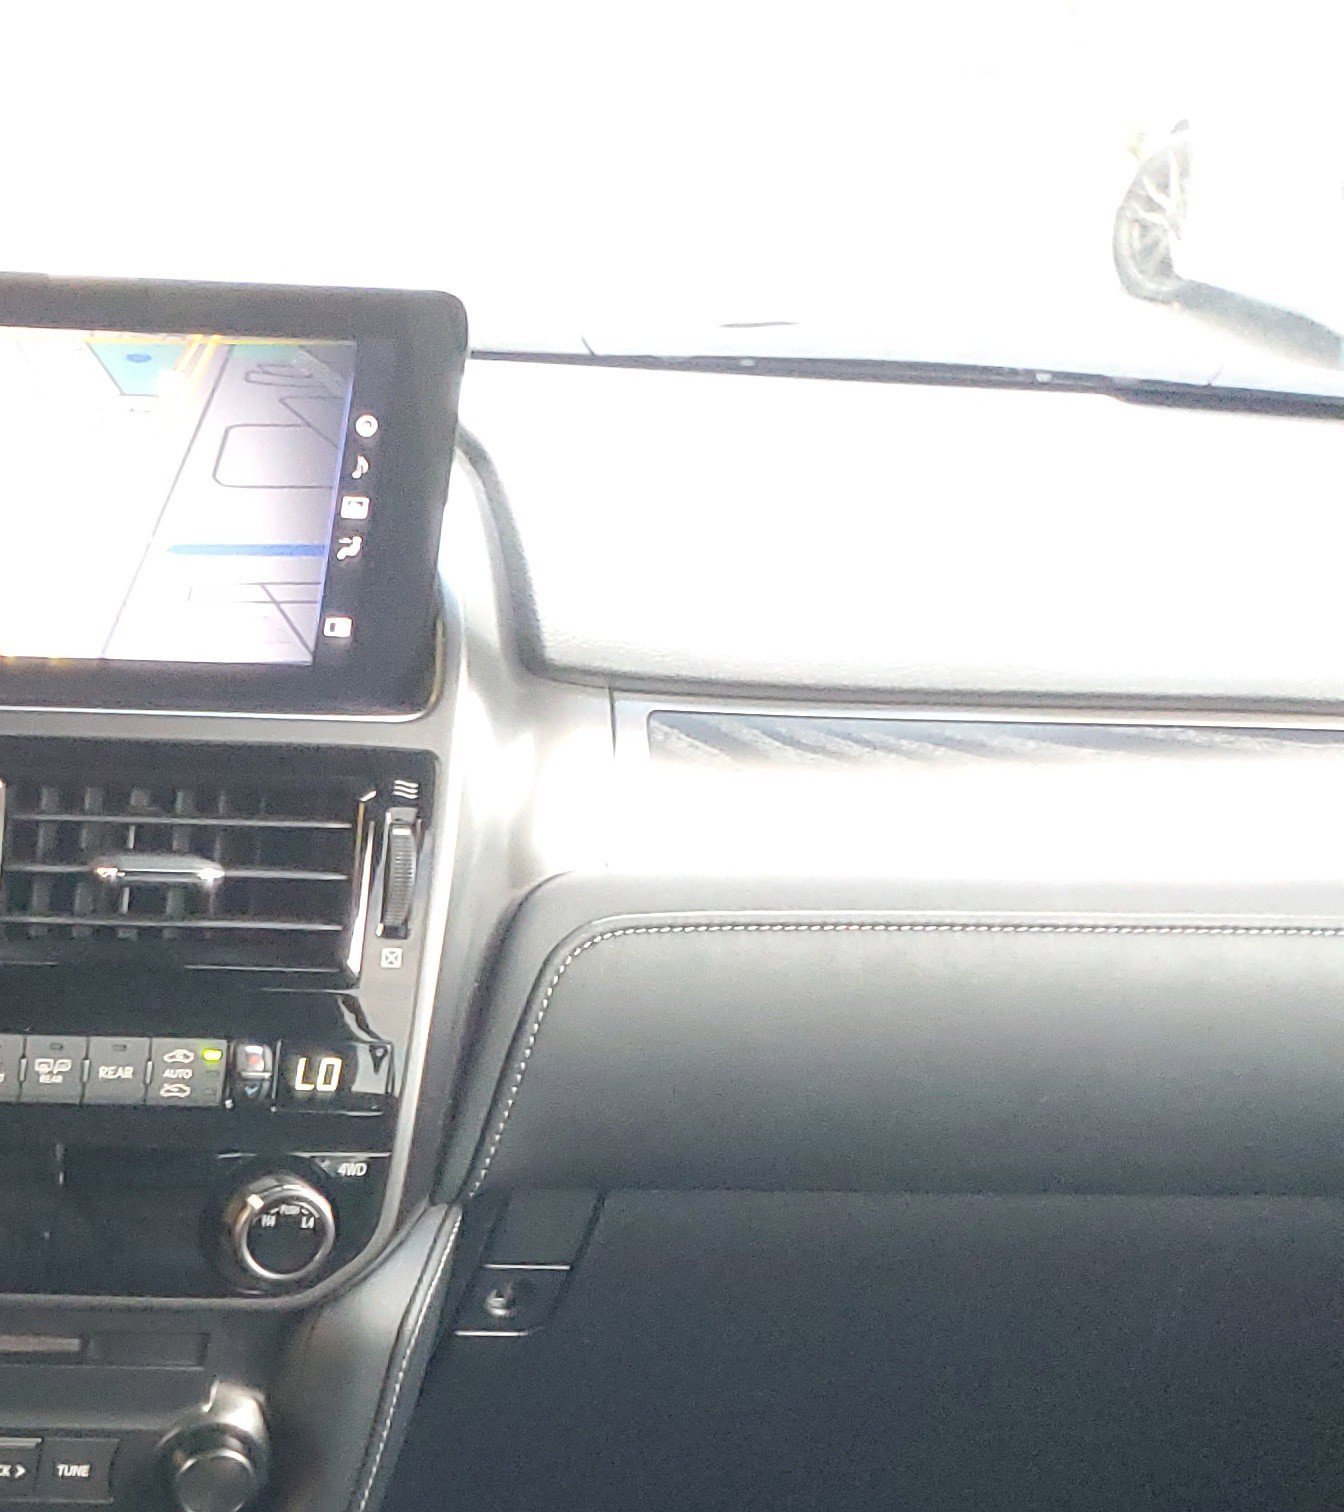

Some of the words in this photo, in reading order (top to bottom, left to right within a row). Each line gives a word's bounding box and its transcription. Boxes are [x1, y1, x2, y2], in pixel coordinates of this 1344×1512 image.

[99, 1065, 134, 1080] REAR
[163, 1068, 193, 1080] AUTO
[337, 1161, 367, 1177] 4WD
[57, 1464, 91, 1477] TUNE
